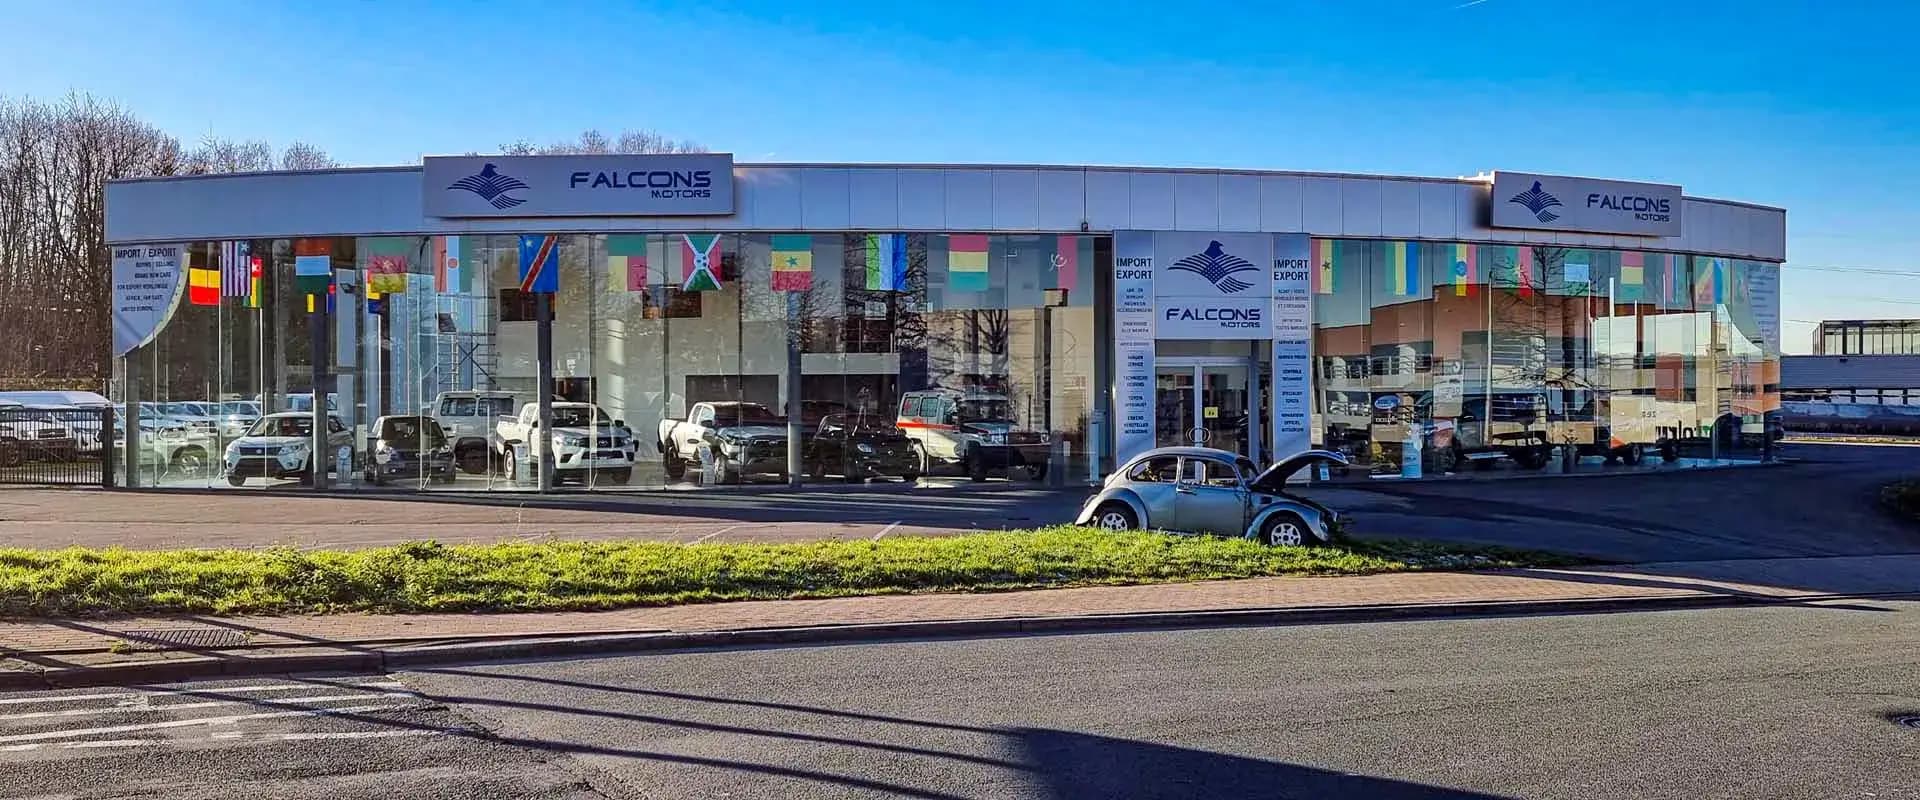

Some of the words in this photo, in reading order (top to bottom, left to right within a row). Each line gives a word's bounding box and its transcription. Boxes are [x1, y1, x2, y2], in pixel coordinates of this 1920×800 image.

[570, 171, 711, 188] FALCONS
[651, 190, 711, 199] MOTORS
[1587, 193, 1671, 213] FALCONS
[1635, 213, 1670, 222] MOTORS
[115, 249, 141, 258] IMPORT
[148, 247, 176, 257] EXPORT
[1116, 257, 1152, 267] IMPORT
[1273, 259, 1309, 269] IMPORT
[1116, 270, 1153, 280] EXPORT
[1273, 271, 1309, 281] EXPORT
[1166, 308, 1261, 321] FALCONS
[1220, 321, 1261, 329] MOTORS
